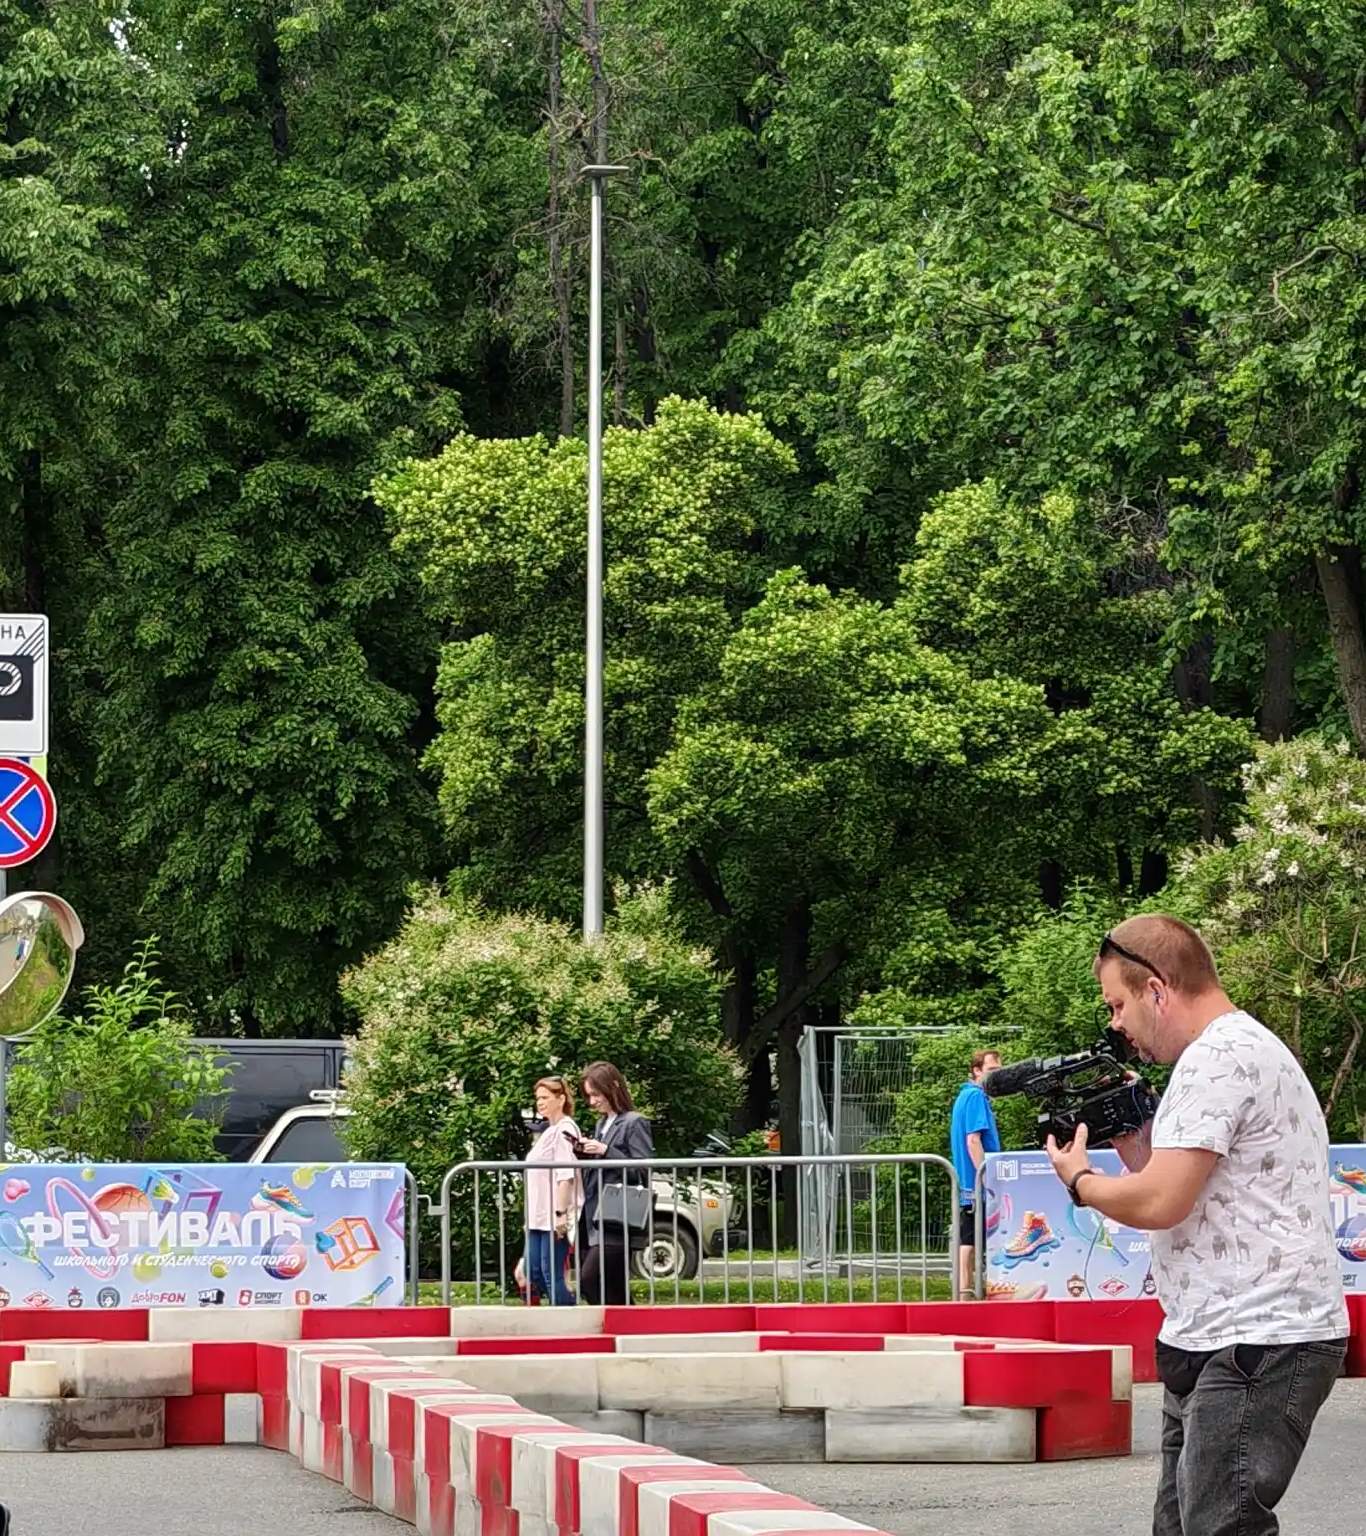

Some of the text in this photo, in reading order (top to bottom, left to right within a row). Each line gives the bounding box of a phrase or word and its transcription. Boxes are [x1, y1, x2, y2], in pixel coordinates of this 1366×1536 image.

[20, 1211, 302, 1248] ФЕСТИВАЛЬ
[53, 1251, 300, 1268] ШКОЛЬНОГО И СТУДЕНЧЕСКОГО СПОРТА
[255, 1292, 283, 1300] СПОРТ
